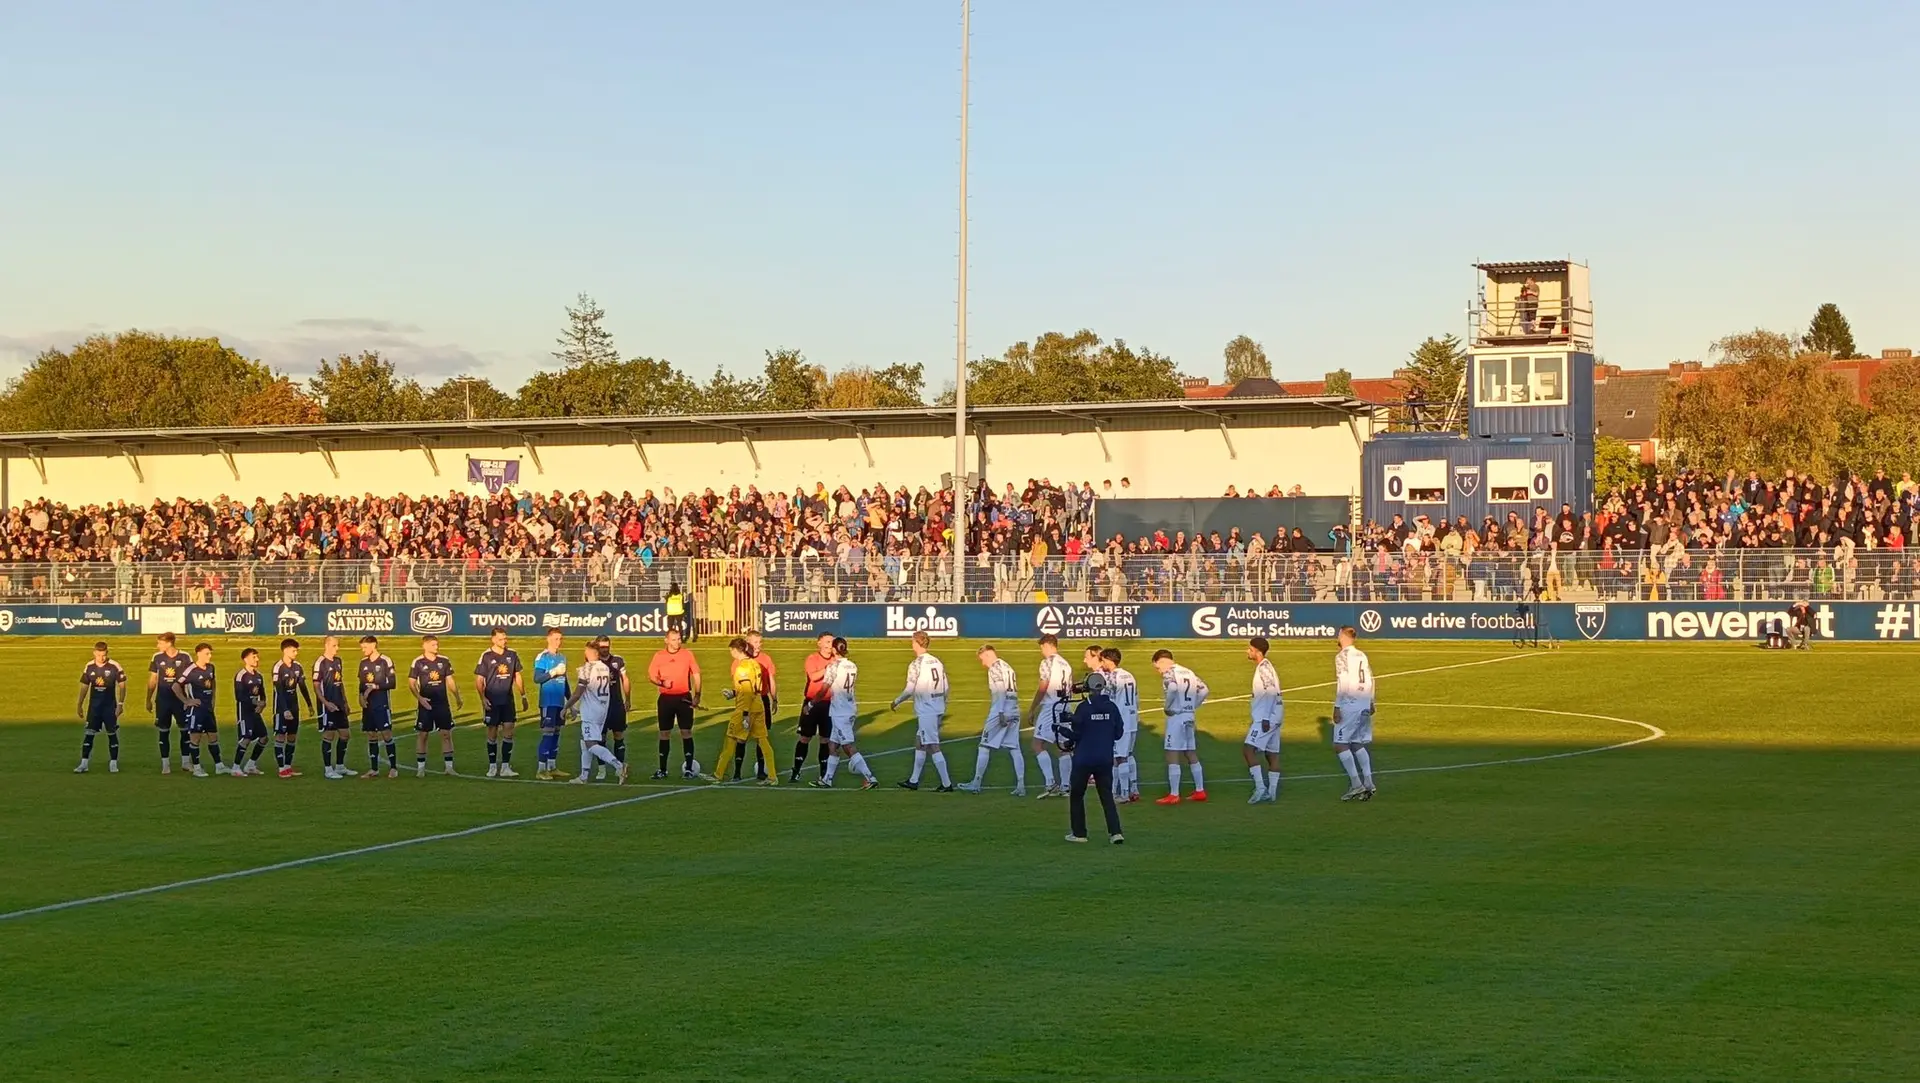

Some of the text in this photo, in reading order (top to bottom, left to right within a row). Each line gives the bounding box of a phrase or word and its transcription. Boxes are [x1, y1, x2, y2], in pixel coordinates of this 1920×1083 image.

[1388, 475, 1403, 497] 0
[1463, 476, 1473, 488] K
[1533, 473, 1549, 495] 0
[784, 611, 839, 620] STADTWERKE
[1067, 605, 1140, 615] ADALBERT
[1227, 607, 1290, 619] Autohaus
[327, 611, 394, 631] SANDERS
[415, 611, 446, 628] Bley
[784, 622, 813, 631] Emden
[887, 606, 958, 635] Hoping
[1067, 616, 1133, 625] JANSSEN
[1390, 613, 1535, 629] we drive football
[1586, 616, 1597, 628] K
[1648, 605, 1835, 638] nevernt
[1066, 627, 1138, 637] GERÜSTBAU
[1227, 623, 1335, 636] Gebr. Schwarte
[931, 668, 939, 690] 9
[1359, 661, 1365, 683] 6
[1124, 682, 1134, 706] 17
[1184, 678, 1191, 701] 2
